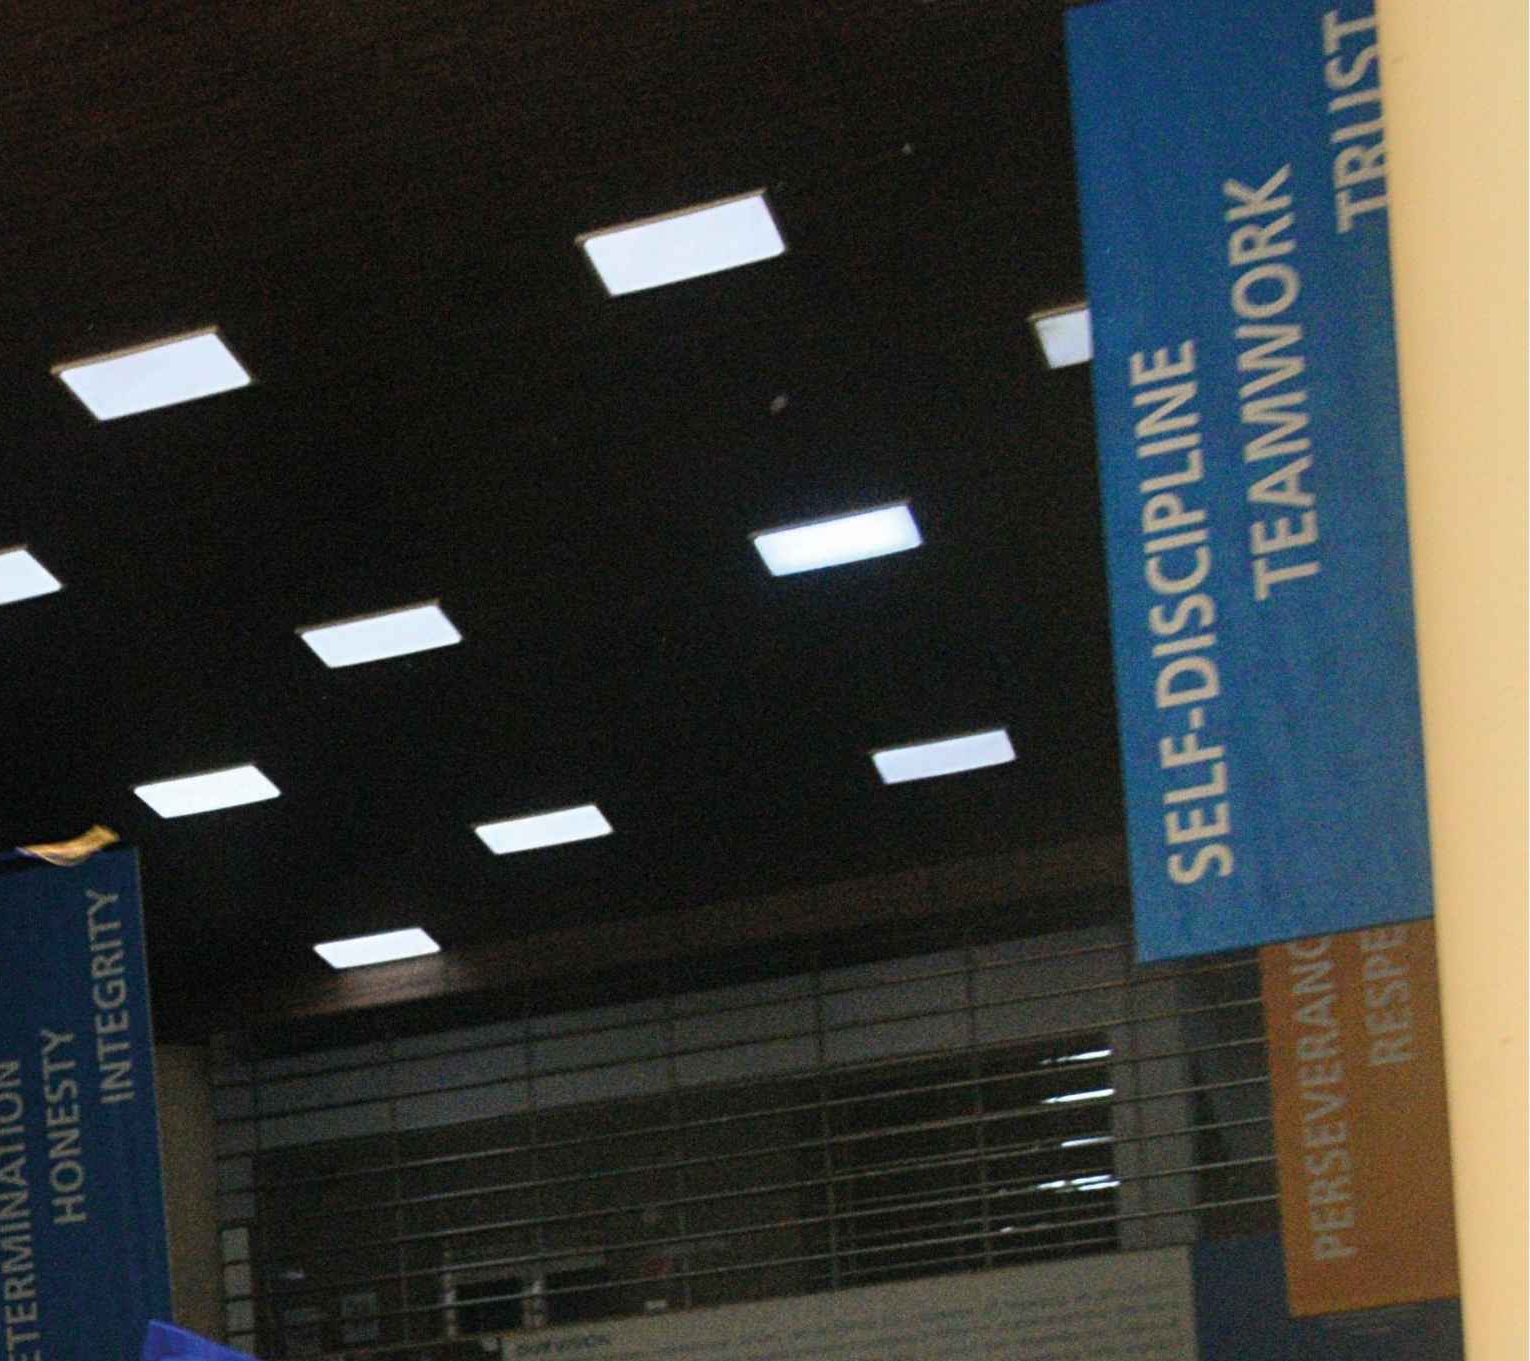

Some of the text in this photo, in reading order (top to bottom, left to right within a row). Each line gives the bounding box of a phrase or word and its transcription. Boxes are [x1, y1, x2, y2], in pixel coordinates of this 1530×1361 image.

[1321, 9, 1387, 235] TRUST
[1224, 162, 1320, 601] TEAMWORK
[1129, 337, 1232, 888] SELF-DISCIPLINE
[85, 887, 134, 1106] INTEGRITY
[40, 1027, 87, 1226] HONESTY
